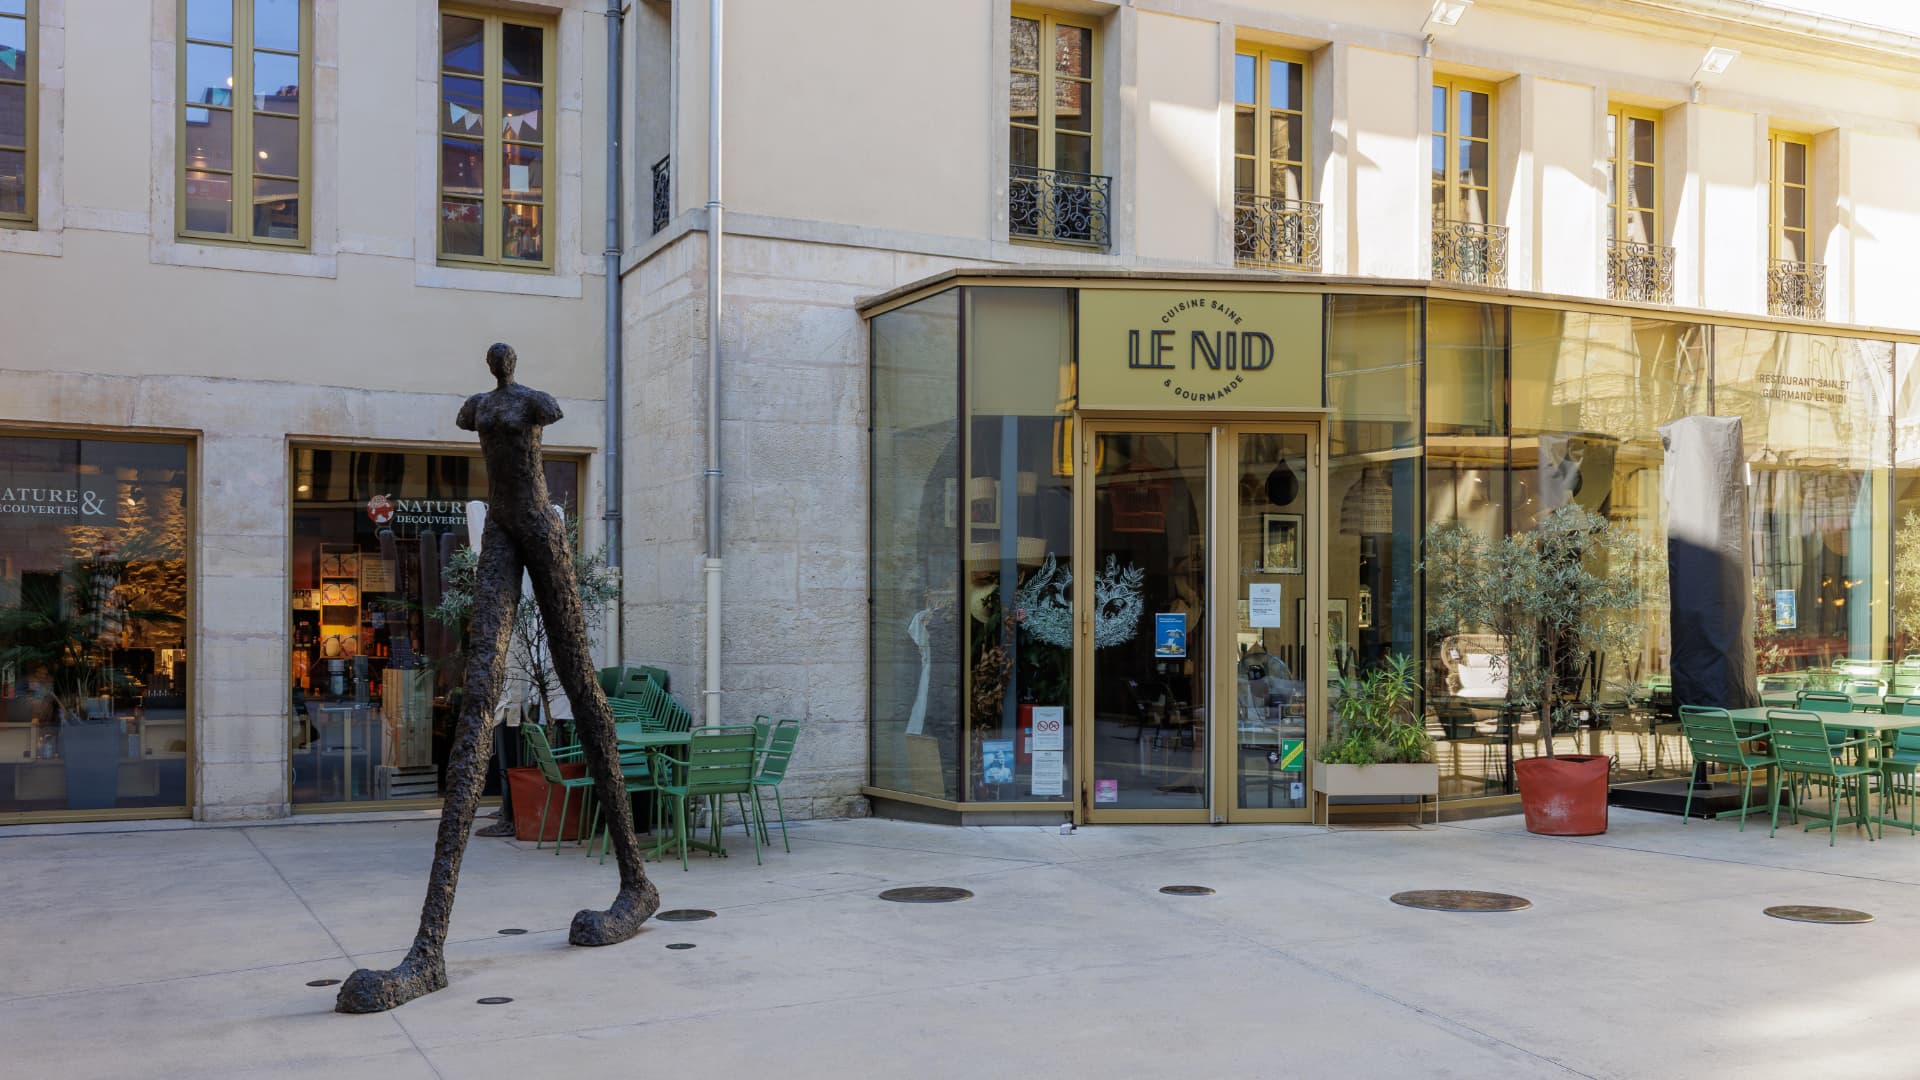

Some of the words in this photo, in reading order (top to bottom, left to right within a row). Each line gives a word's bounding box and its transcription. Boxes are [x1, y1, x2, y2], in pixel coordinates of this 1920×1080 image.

[1161, 299, 1206, 323] CUISINE
[1211, 300, 1243, 325] SAINE
[1128, 329, 1175, 369] LE
[1191, 330, 1274, 371] NID
[1163, 378, 1172, 388] &
[1174, 374, 1244, 402] GOURMANDE
[1759, 374, 1815, 386] RESTAURANT
[1762, 389, 1812, 402] GOURMAND
[0, 504, 79, 515] COUVERTES
[1, 487, 79, 503] ATURE
[81, 490, 105, 515] &
[397, 500, 467, 514] NATUR
